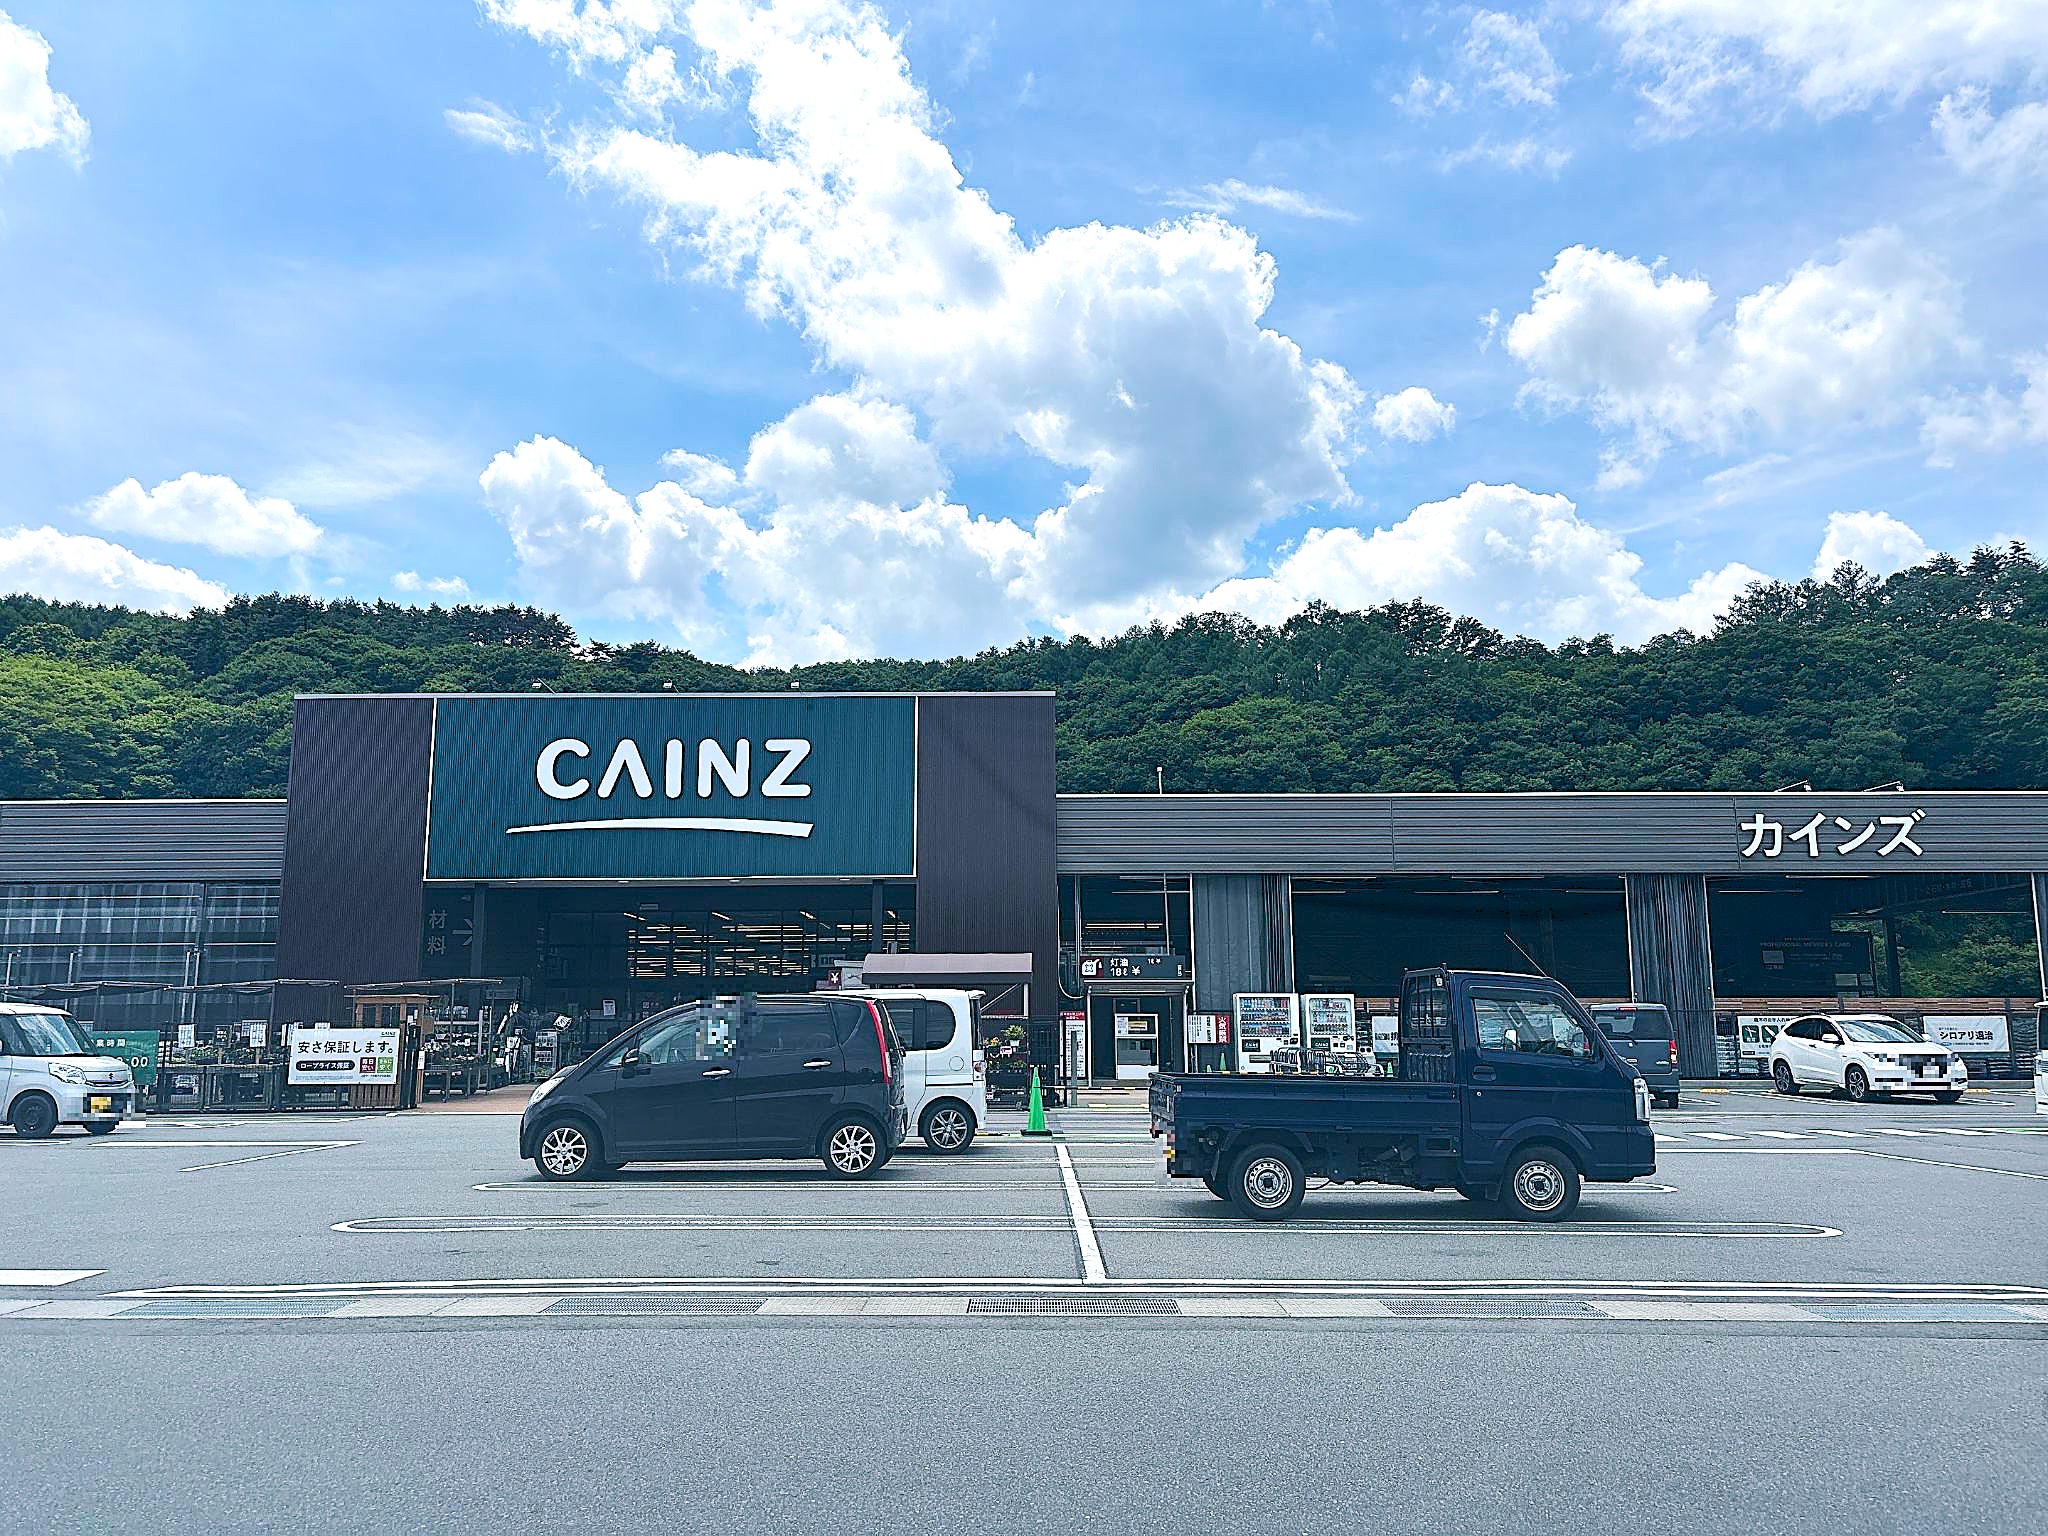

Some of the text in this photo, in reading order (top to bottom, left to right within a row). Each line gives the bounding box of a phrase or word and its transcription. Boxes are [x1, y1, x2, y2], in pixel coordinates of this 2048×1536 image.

[536, 738, 813, 800] CAINZ
[1740, 808, 1927, 857] カインズ
[1110, 957, 1129, 967] 灯油
[1940, 1031, 1993, 1040] シロアリ退治
[297, 1040, 394, 1054] 安さ保証します。
